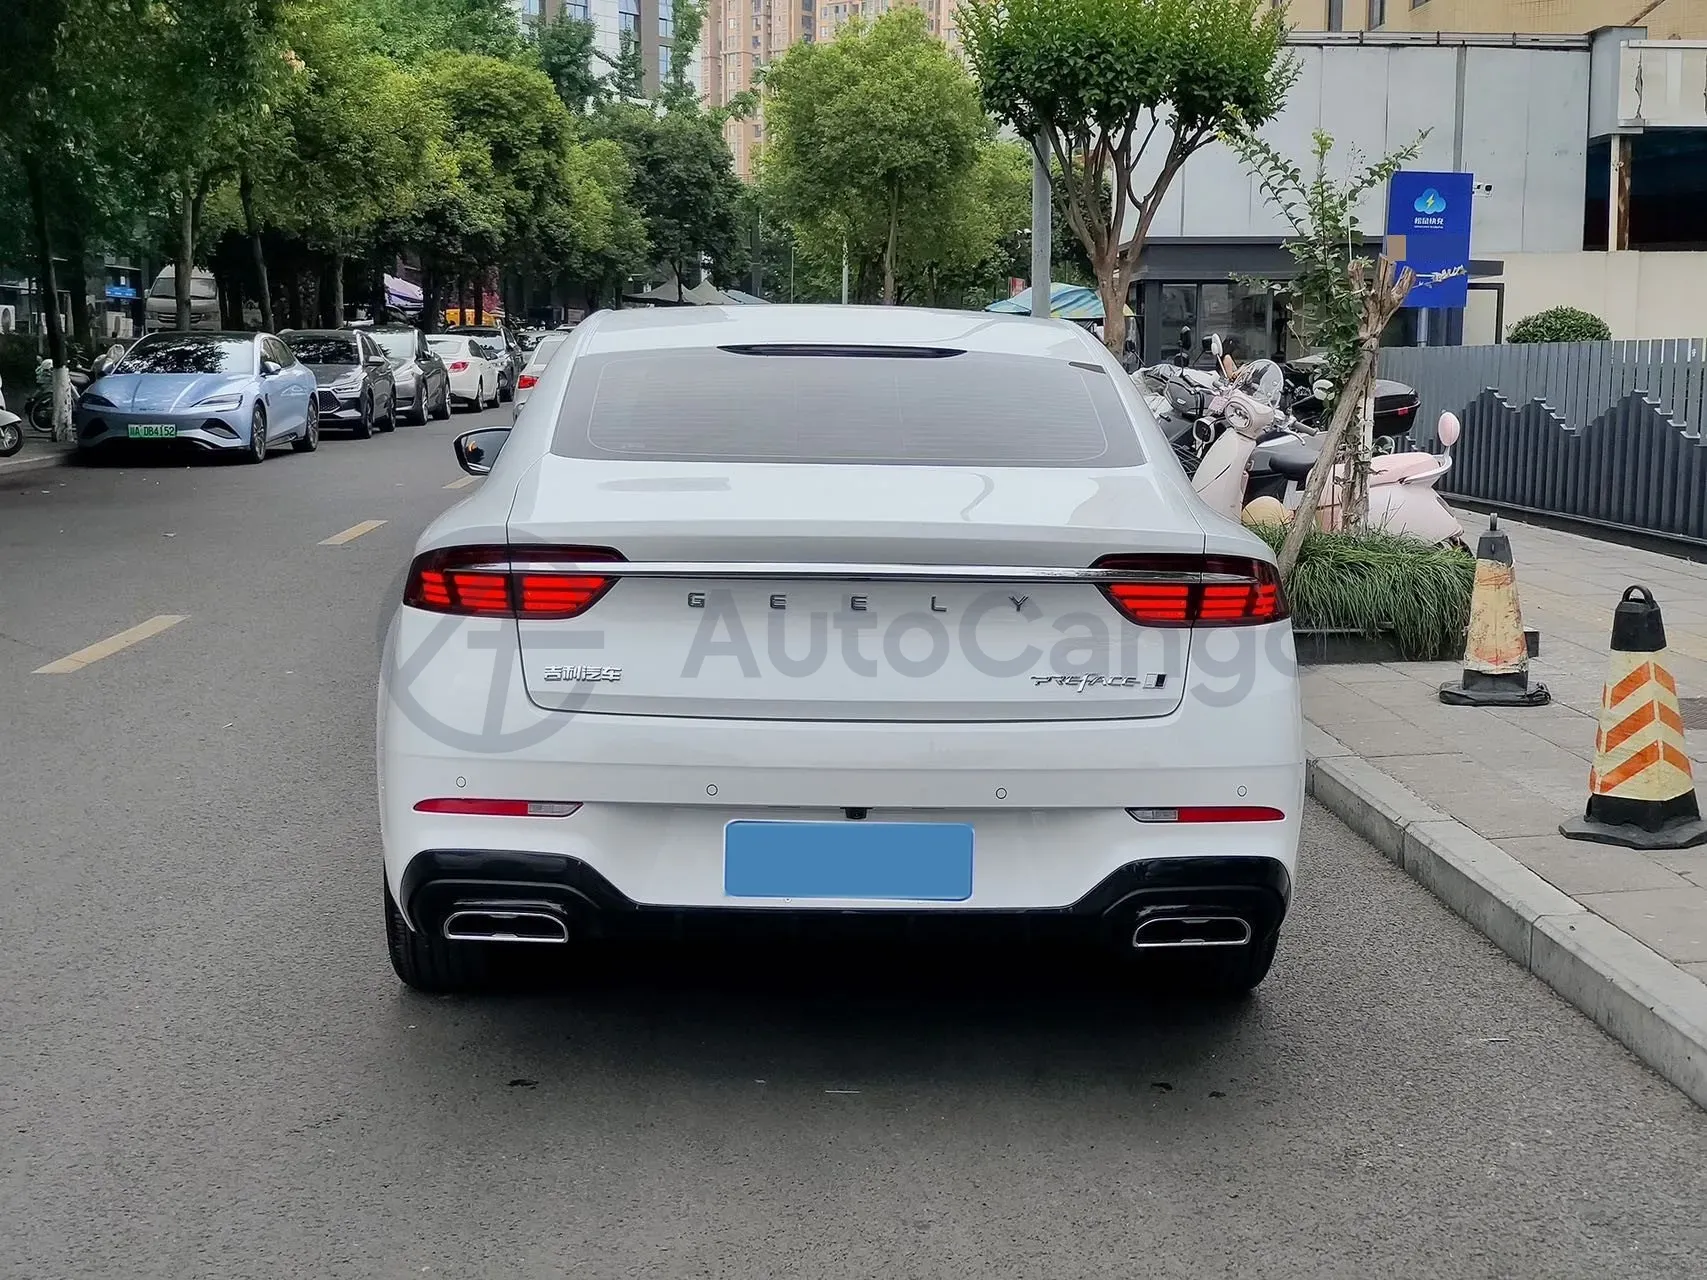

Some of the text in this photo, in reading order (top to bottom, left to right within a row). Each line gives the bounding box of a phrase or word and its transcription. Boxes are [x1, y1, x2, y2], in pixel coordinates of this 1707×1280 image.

[687, 592, 1030, 613] GEELY
[544, 665, 622, 682] 吉利汽车
